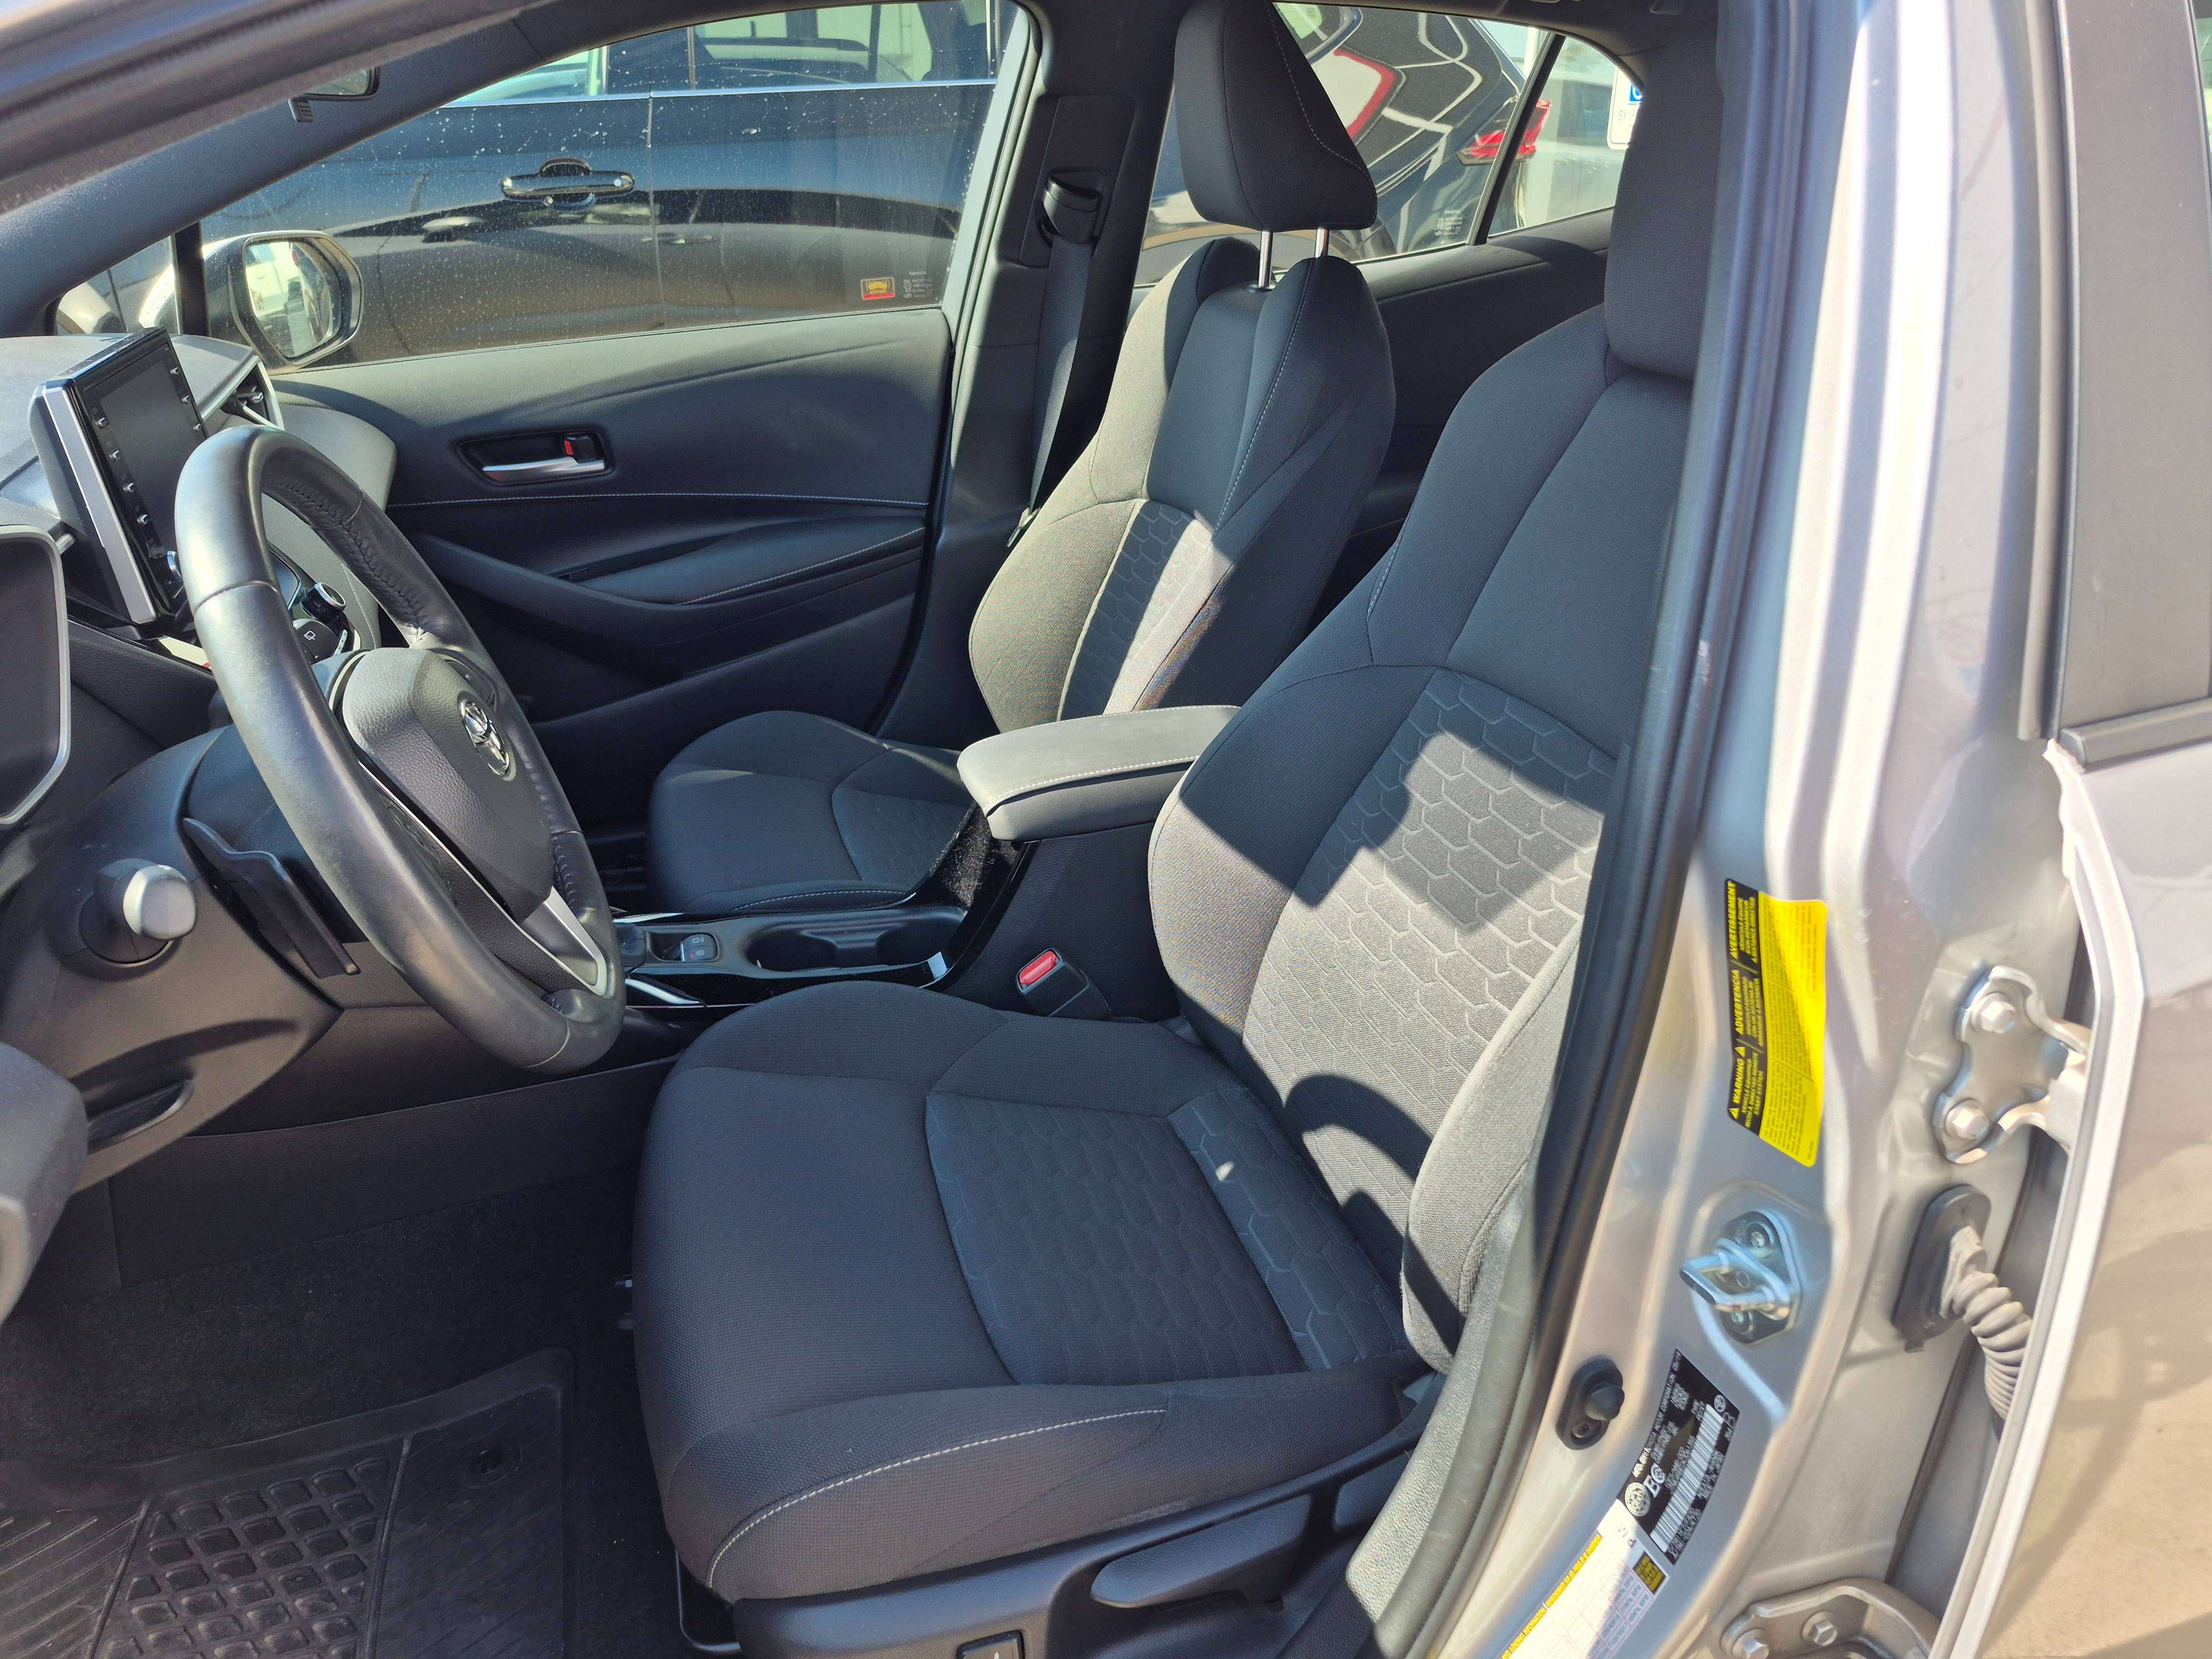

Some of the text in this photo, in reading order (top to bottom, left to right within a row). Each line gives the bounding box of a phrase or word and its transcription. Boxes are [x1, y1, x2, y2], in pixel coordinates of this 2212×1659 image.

[1618, 109, 1627, 121] BY
[1728, 881, 1738, 959] AVERTISSEMENT
[1731, 970, 1744, 1035] ADVERTENCIA
[1732, 1058, 1744, 1104] WARNING
[1741, 1088, 1750, 1114] VEHICLE
[1660, 1371, 1676, 1412] CORPORATION
